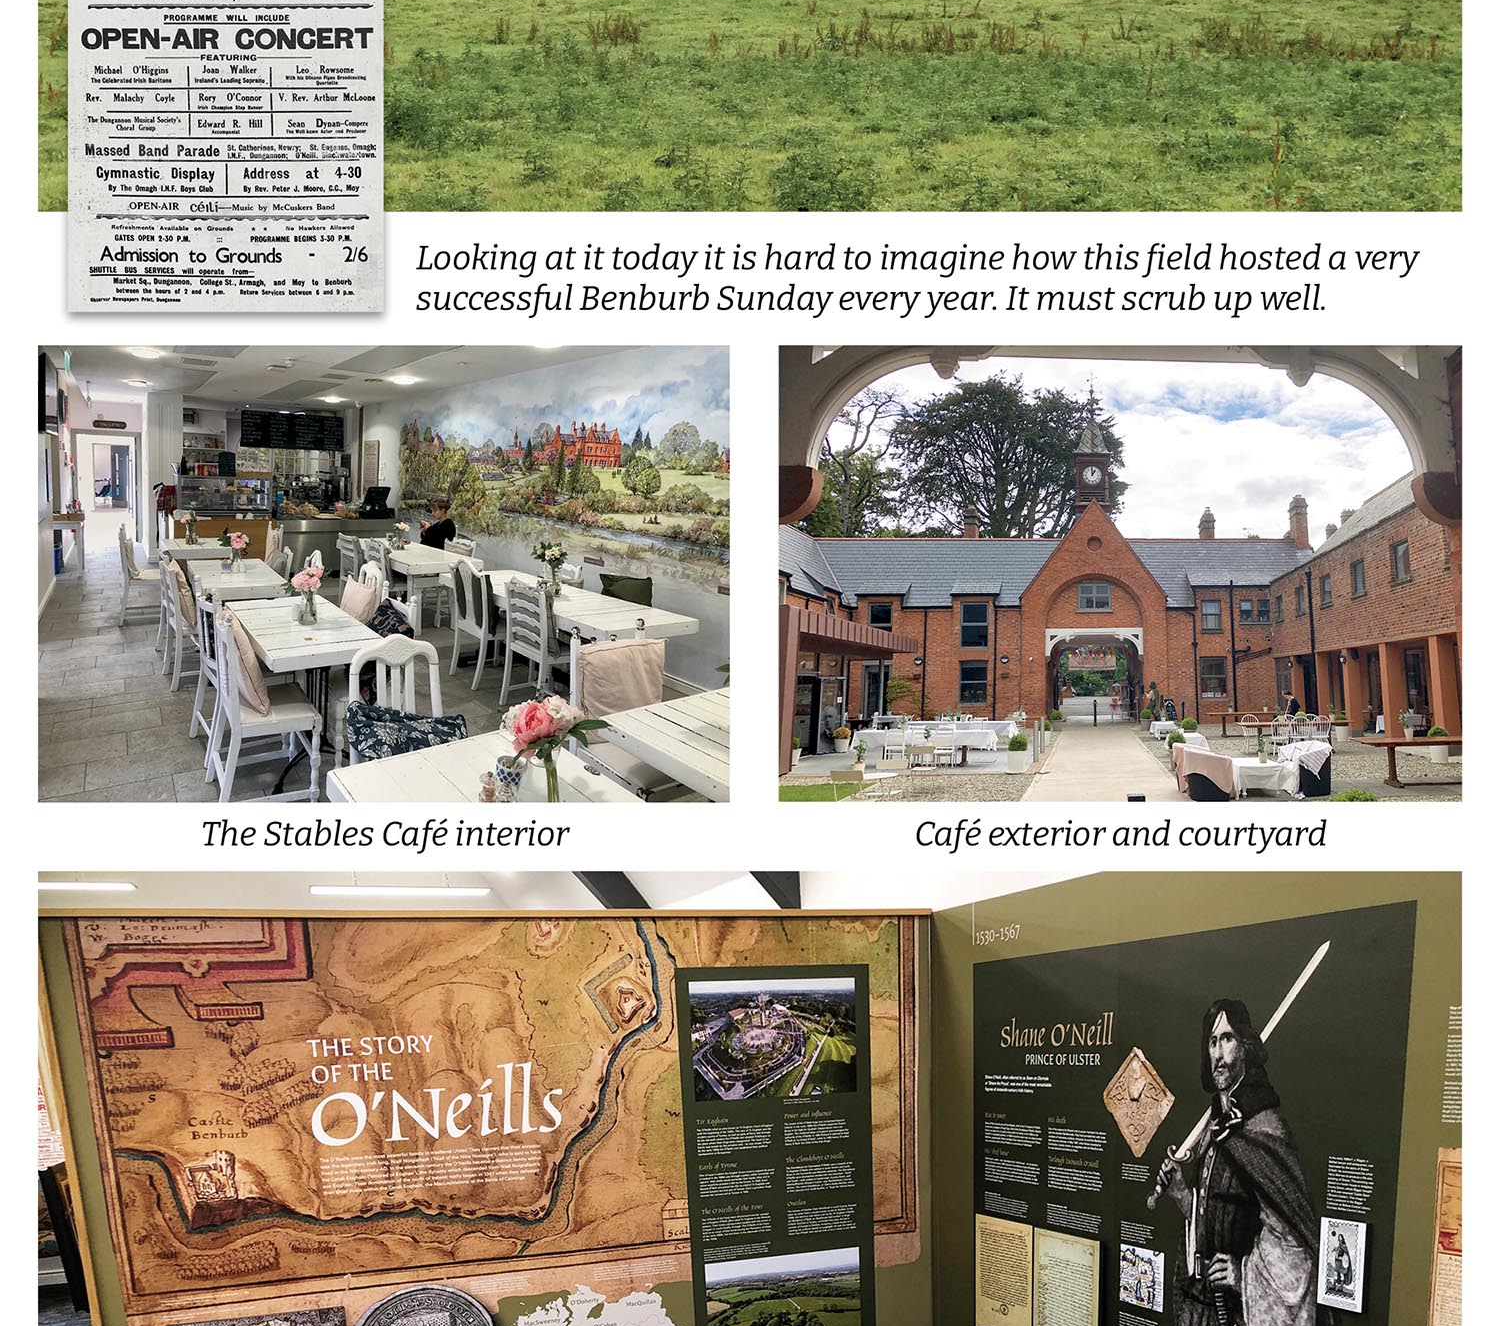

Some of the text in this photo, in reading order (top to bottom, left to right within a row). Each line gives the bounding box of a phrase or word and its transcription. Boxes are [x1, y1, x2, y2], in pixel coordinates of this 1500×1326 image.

[163, 14, 290, 22] PROGRAMME WILL INCLUDE
[80, 27, 374, 50] OPEN-AIR CONCERT
[200, 53, 257, 62] FEATURING
[94, 65, 169, 77] Michael O'Higgins
[202, 64, 258, 75] Joan Walker
[295, 64, 355, 75] Leo Rowsome
[85, 92, 176, 104] Rev. Malachy Coyle
[198, 92, 263, 104] Rory O'Connor
[278, 92, 376, 102] V. Rev. Arthur McLoone
[197, 118, 263, 129] Edward R. Hill
[84, 143, 220, 158] Massed Band Parade
[96, 165, 215, 184] Gymnastic Display
[243, 166, 362, 180] Address at 4-30
[126, 201, 180, 211] OPEN-AIR
[257, 203, 268, 213] by
[272, 203, 313, 211] McCuskers
[316, 203, 336, 211] Band
[99, 245, 369, 264] Admission to Grounds 2/6
[88, 265, 175, 275] SHUTTLE BUS SERVICES
[1000, 1017, 1046, 1048] Shane
[307, 1035, 433, 1058] THE STORY
[1025, 1053, 1101, 1066] PRINCE OF ULSTER
[312, 1062, 393, 1084] OF THE
[570, 1297, 600, 1306] O'Doherty
[626, 1299, 657, 1308] MacQuillan
